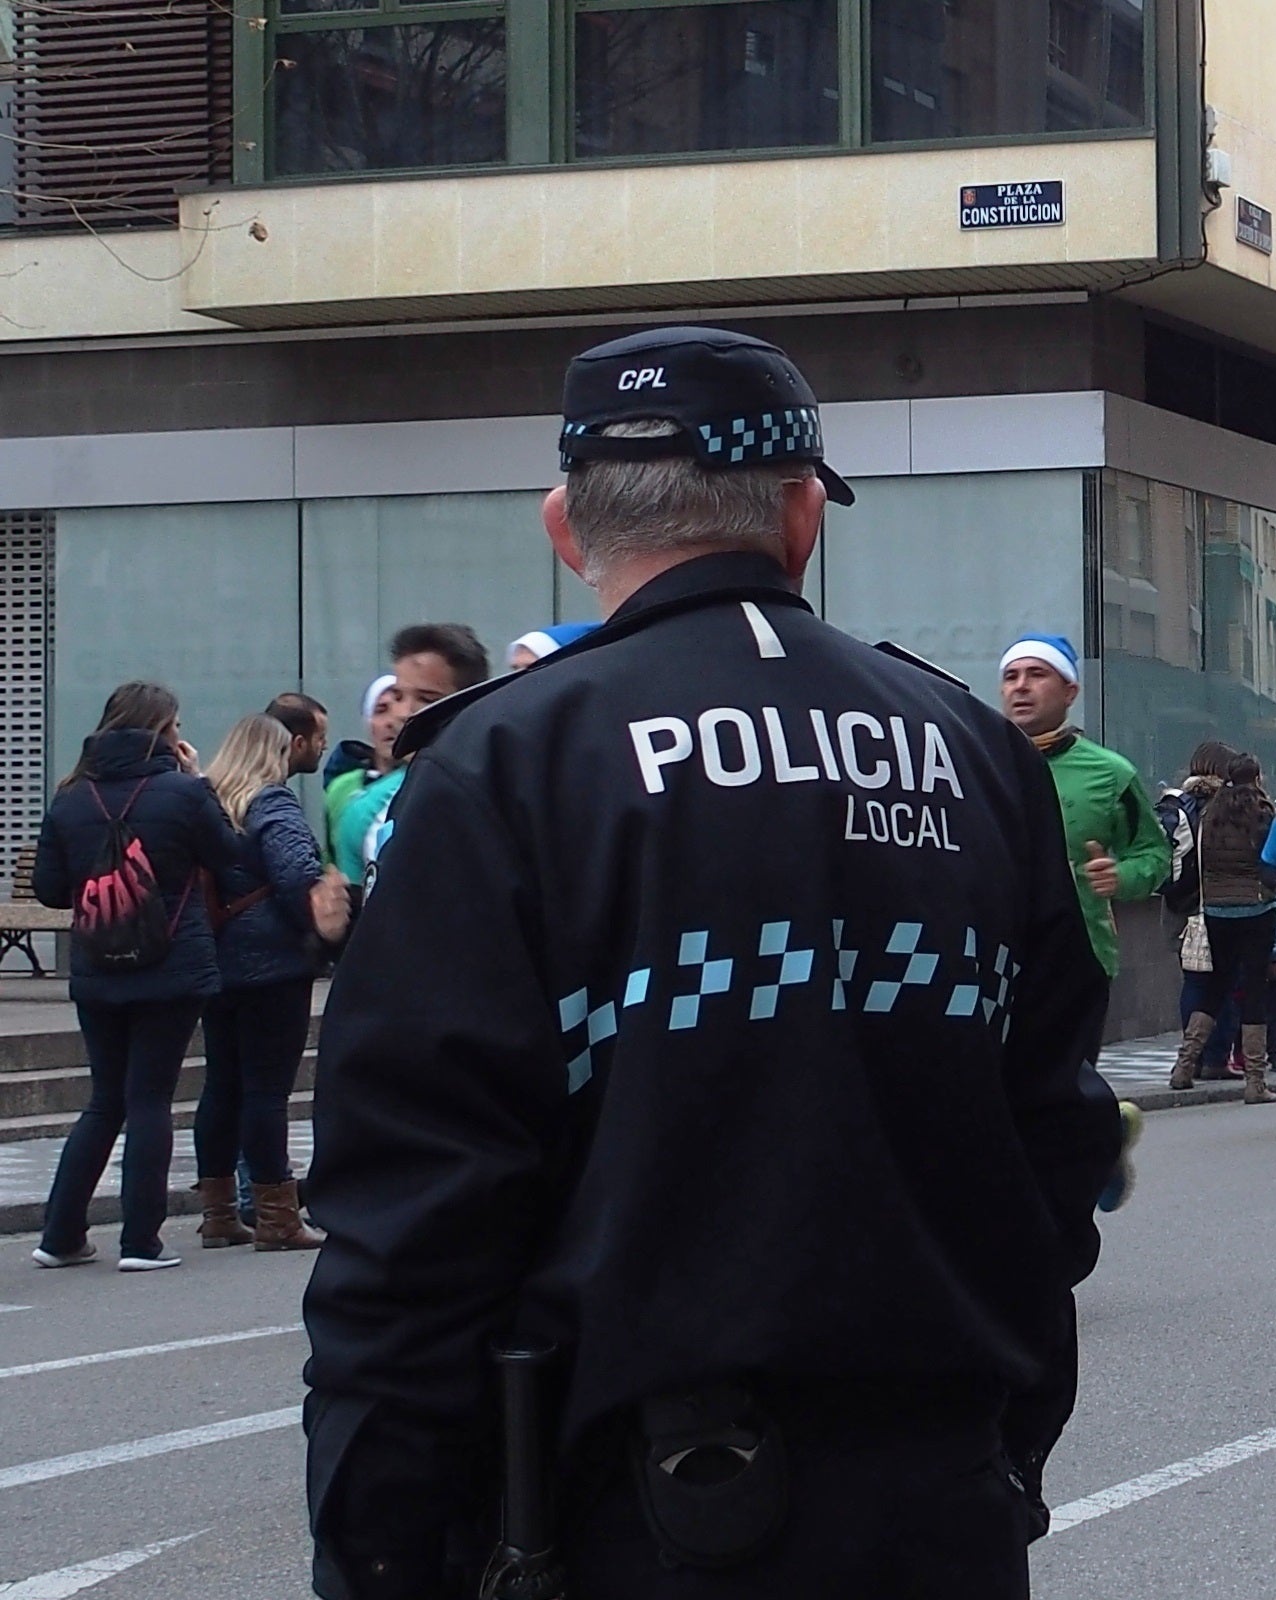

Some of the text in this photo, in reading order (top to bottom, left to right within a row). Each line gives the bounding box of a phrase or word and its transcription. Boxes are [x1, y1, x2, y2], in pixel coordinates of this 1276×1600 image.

[997, 183, 1042, 196] PLAZA
[1003, 196, 1036, 206] DE LA
[962, 202, 1060, 226] CONSTITUCION
[618, 367, 667, 391] CPL
[628, 707, 965, 800] POLICIA
[845, 795, 961, 852] LOCAL
